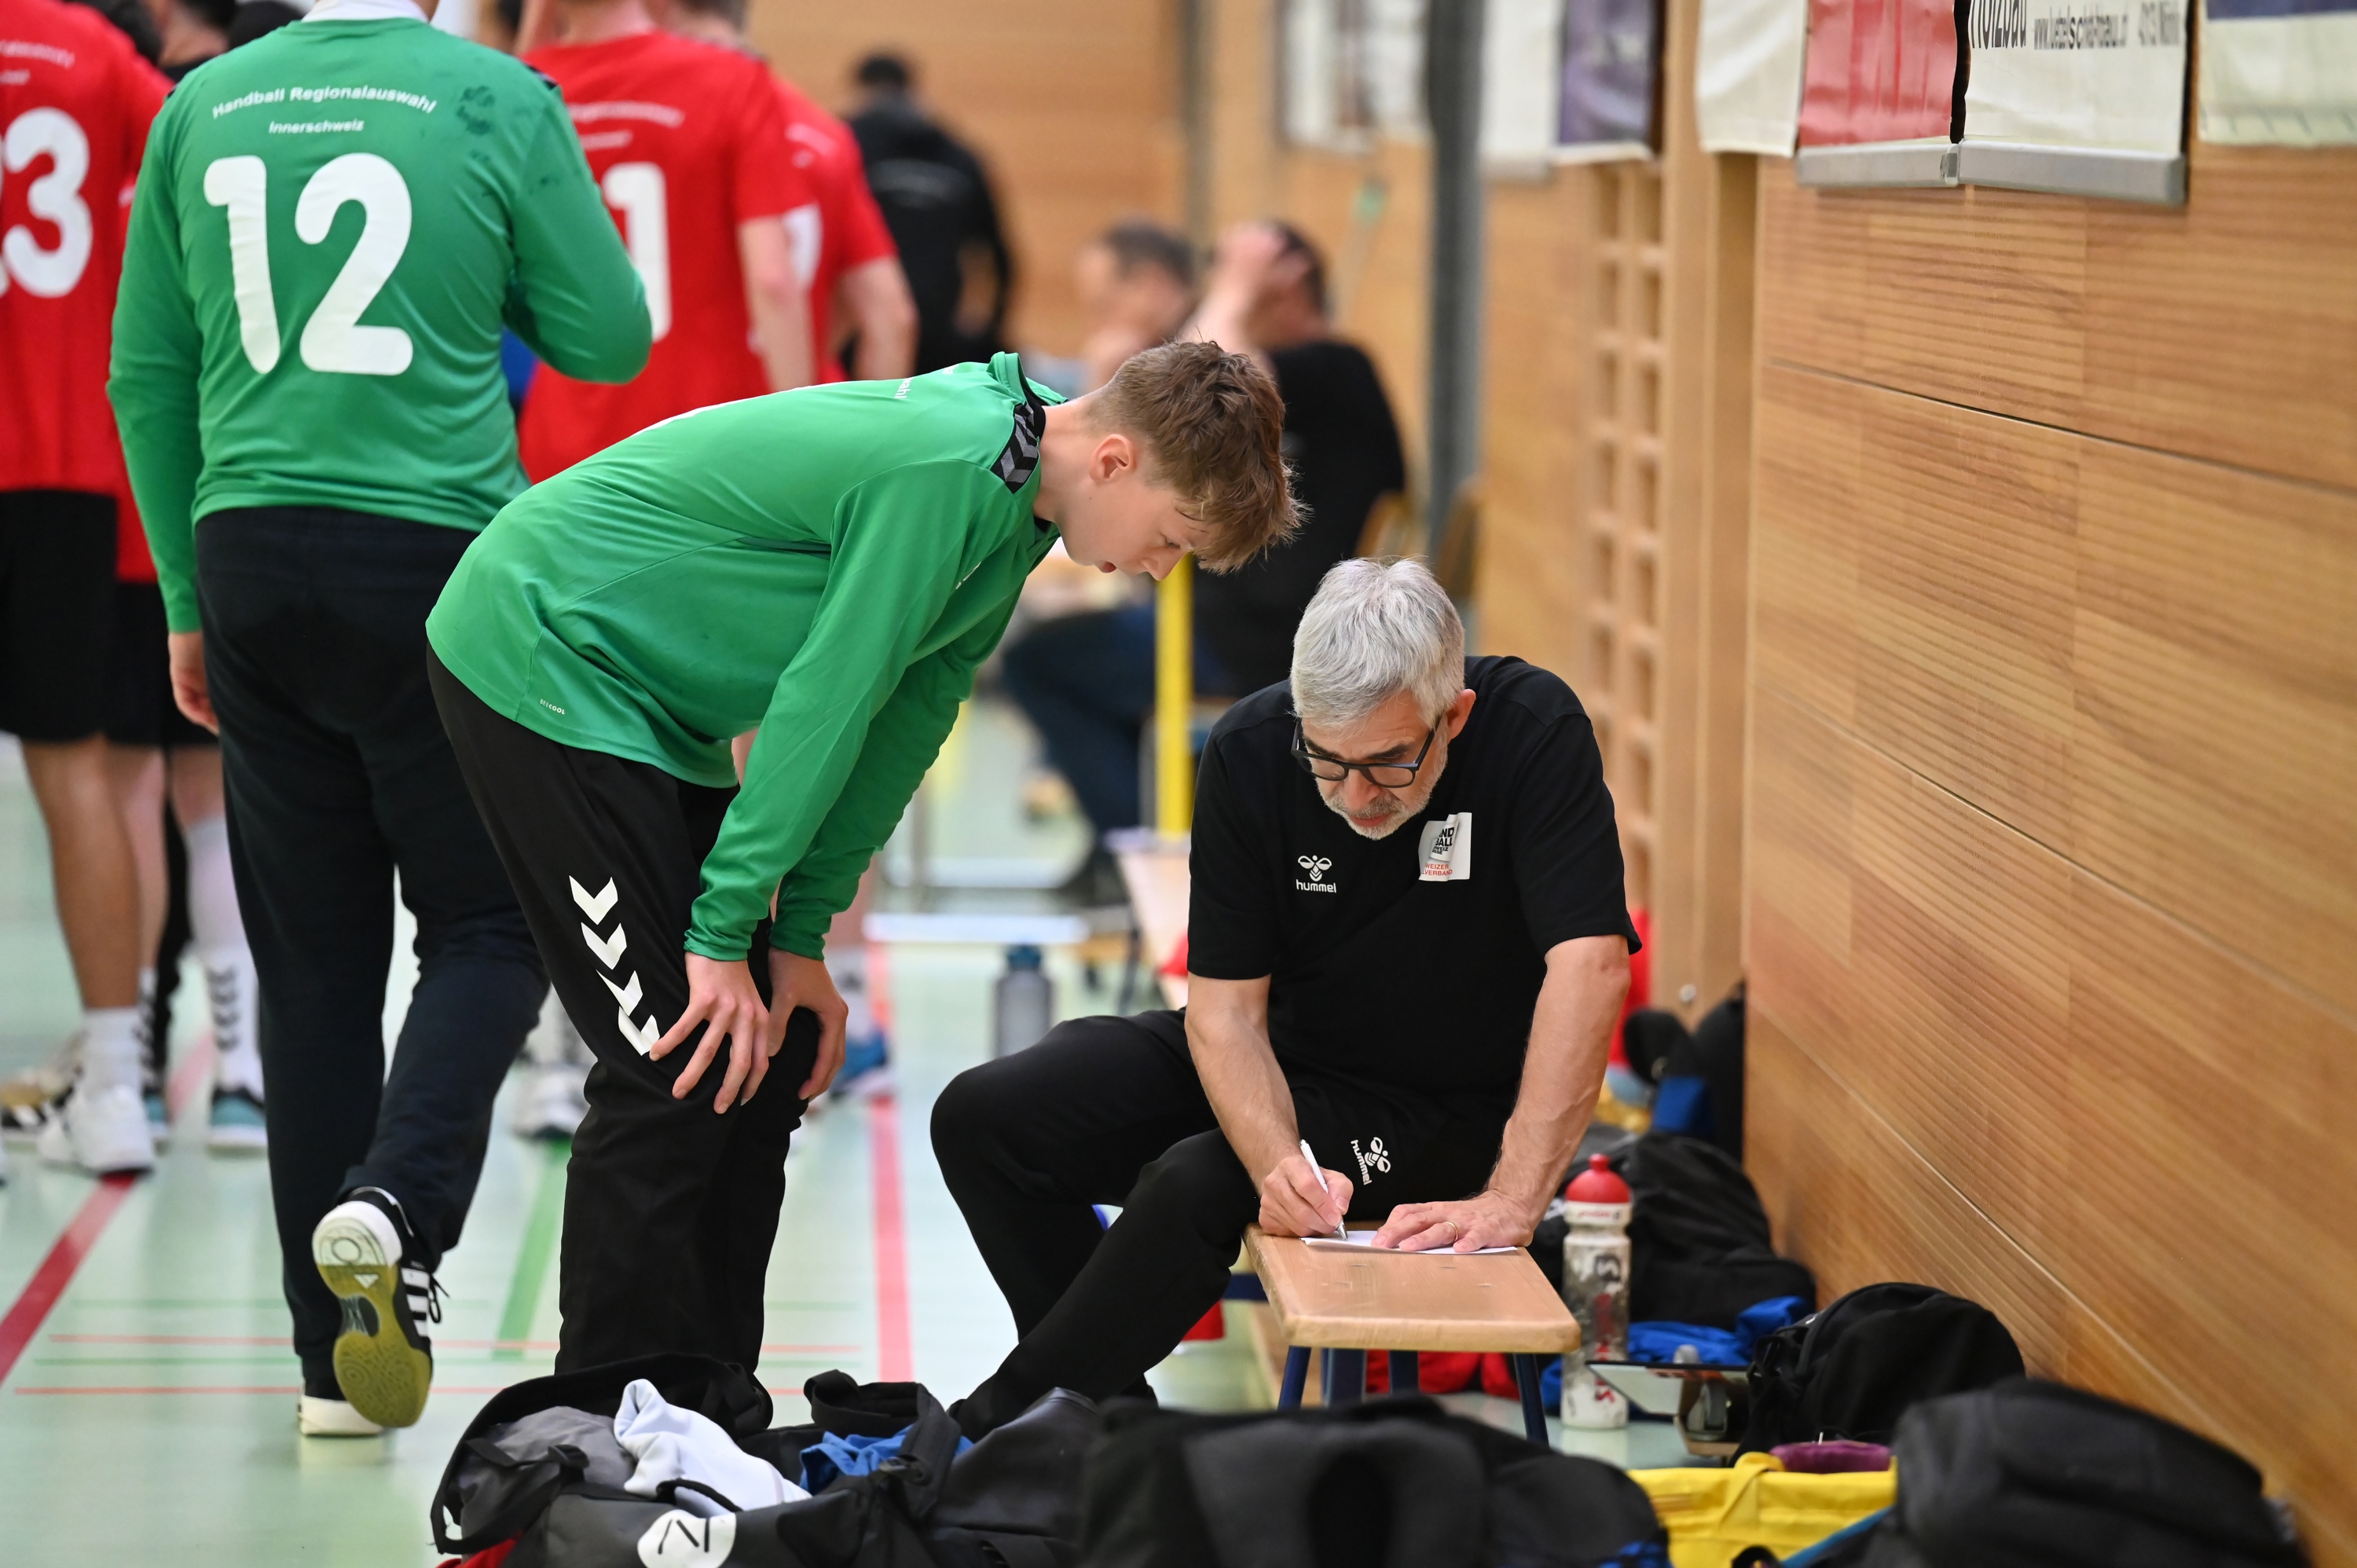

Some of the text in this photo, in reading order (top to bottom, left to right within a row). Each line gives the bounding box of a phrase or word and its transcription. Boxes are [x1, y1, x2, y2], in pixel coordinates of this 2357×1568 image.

[212, 85, 438, 119] Handball Regionalauswahl
[268, 119, 365, 134] Innerschweiz
[0, 105, 93, 299] 3
[203, 152, 414, 376] 12
[1296, 878, 1337, 894] hummel
[1350, 1139, 1373, 1185] hummel
